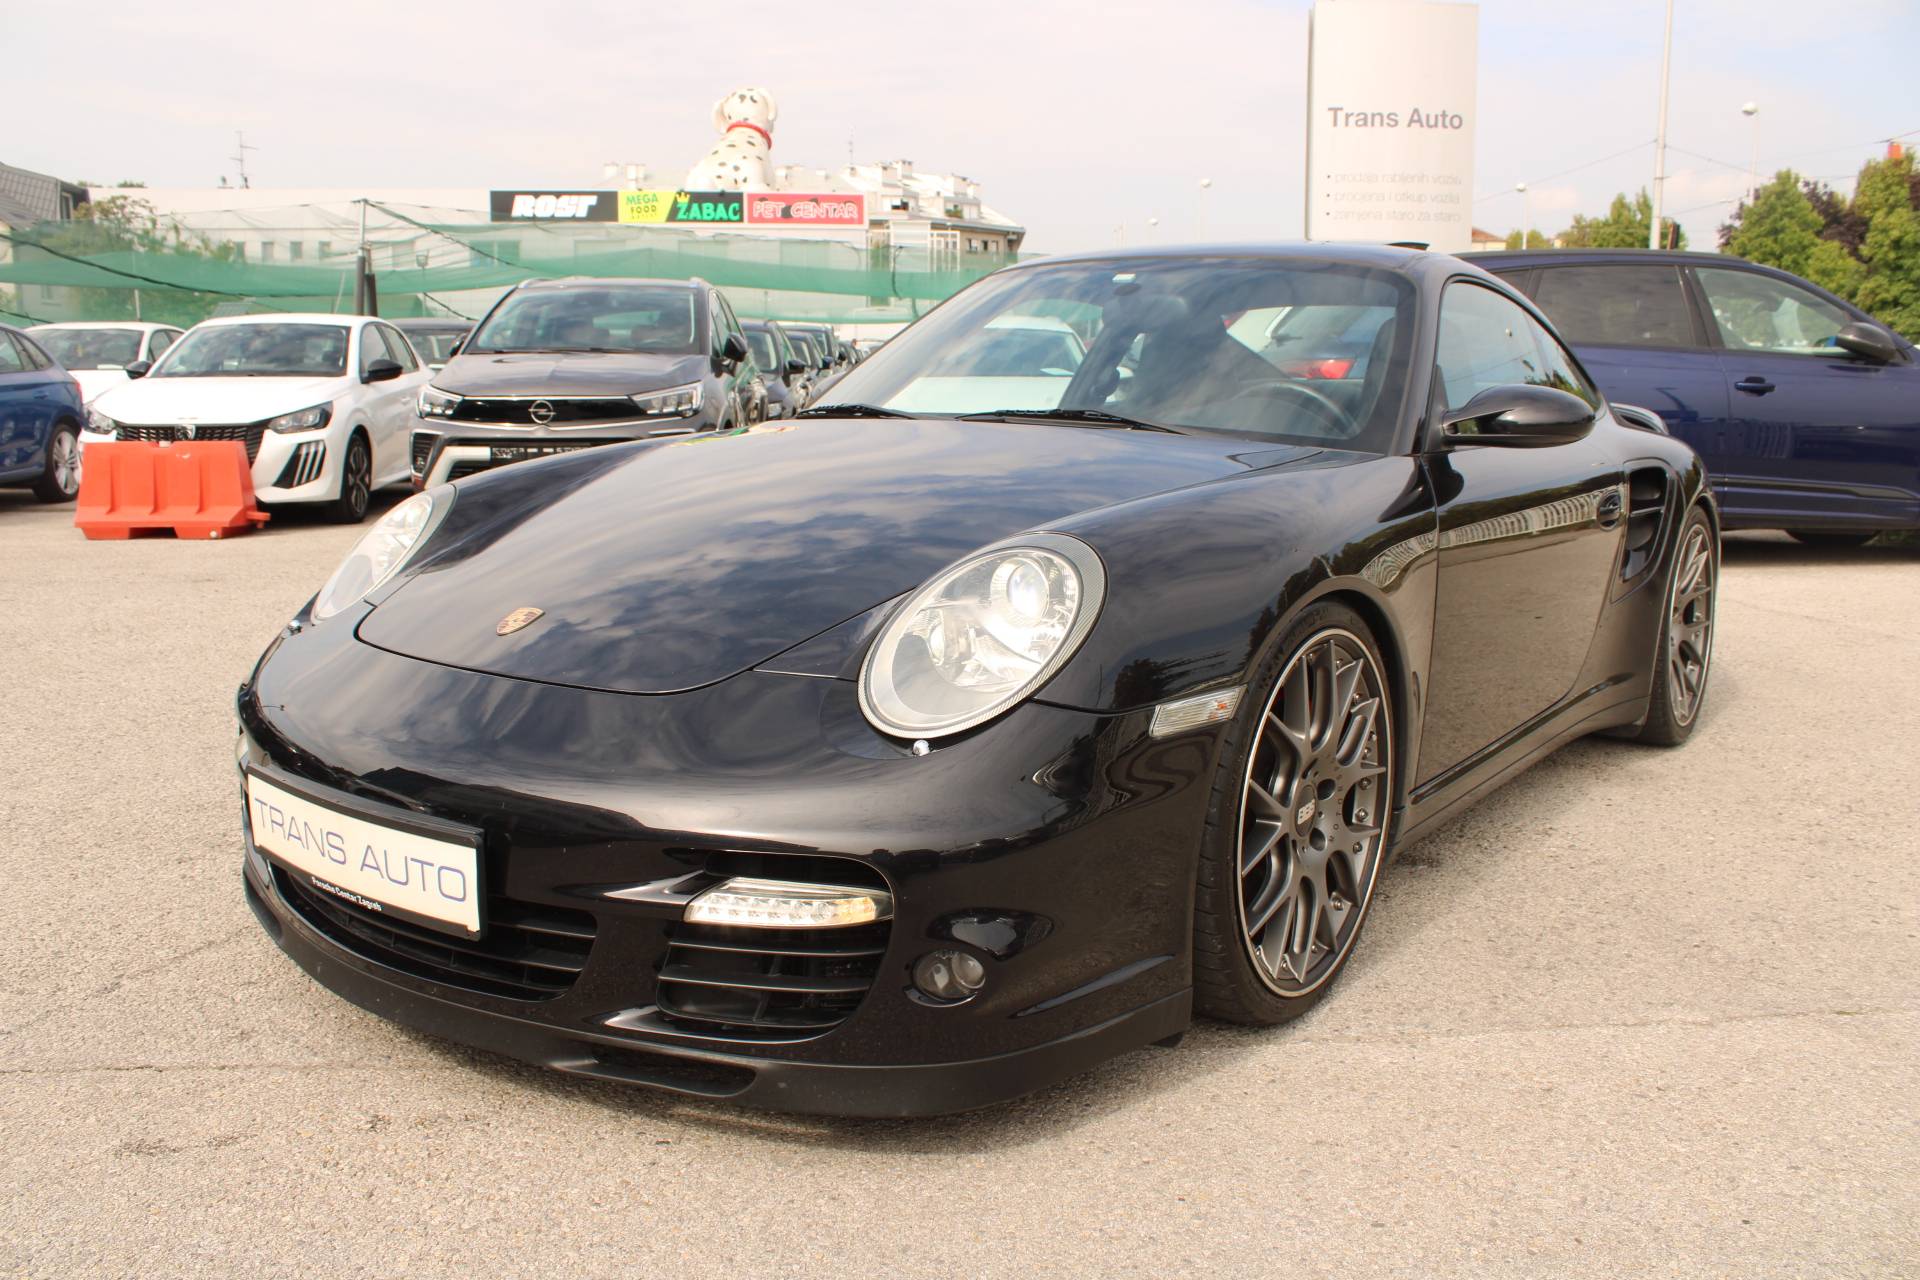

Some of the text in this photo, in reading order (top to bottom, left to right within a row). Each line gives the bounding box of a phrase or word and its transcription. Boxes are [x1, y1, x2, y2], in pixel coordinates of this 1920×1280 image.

[1328, 106, 1464, 130] Trans Auto
[626, 193, 658, 205] MEGA
[630, 204, 657, 214] FOOD
[752, 201, 858, 219] PET CENTAR
[254, 797, 467, 903] TRANS AUTO
